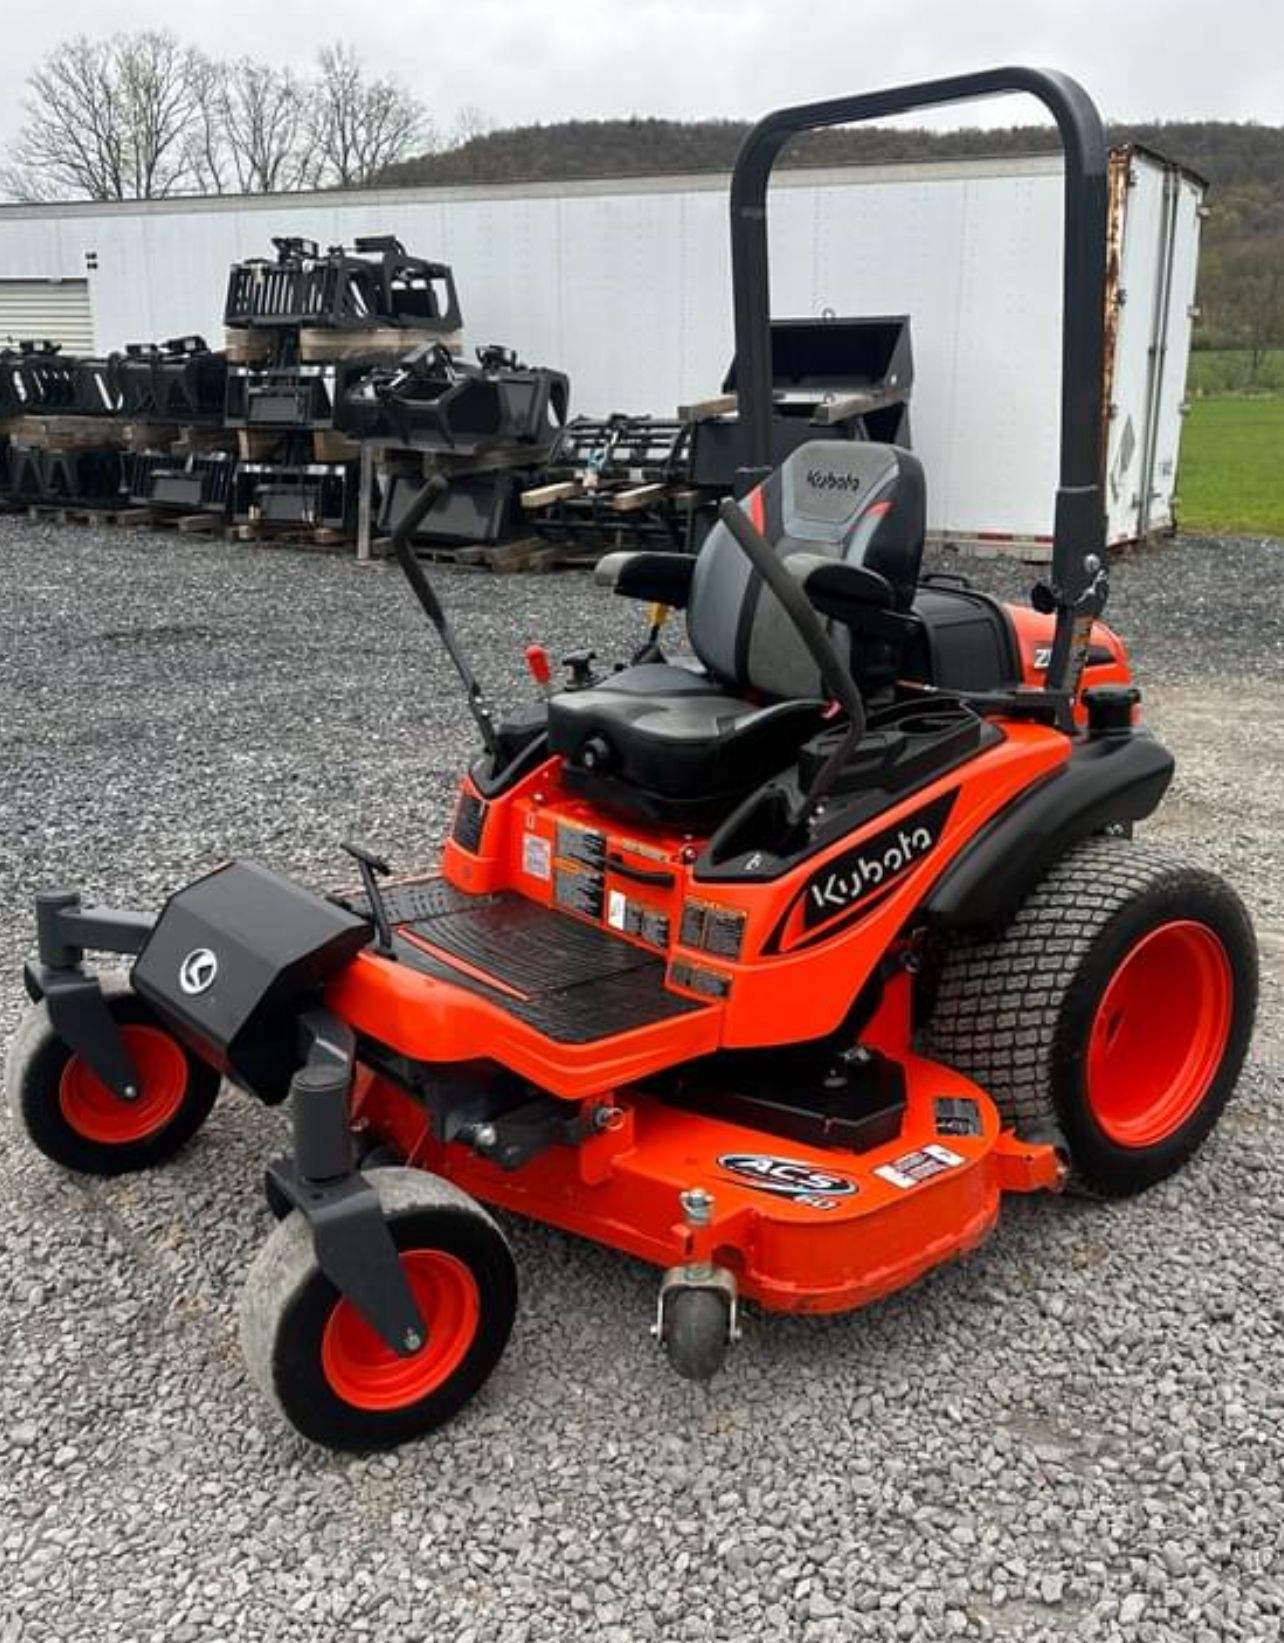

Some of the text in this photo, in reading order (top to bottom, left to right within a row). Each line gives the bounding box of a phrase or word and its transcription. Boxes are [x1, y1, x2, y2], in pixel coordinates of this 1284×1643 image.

[806, 470, 859, 491] Kubota
[811, 827, 932, 906] Kubota
[731, 1157, 844, 1189] ACS
